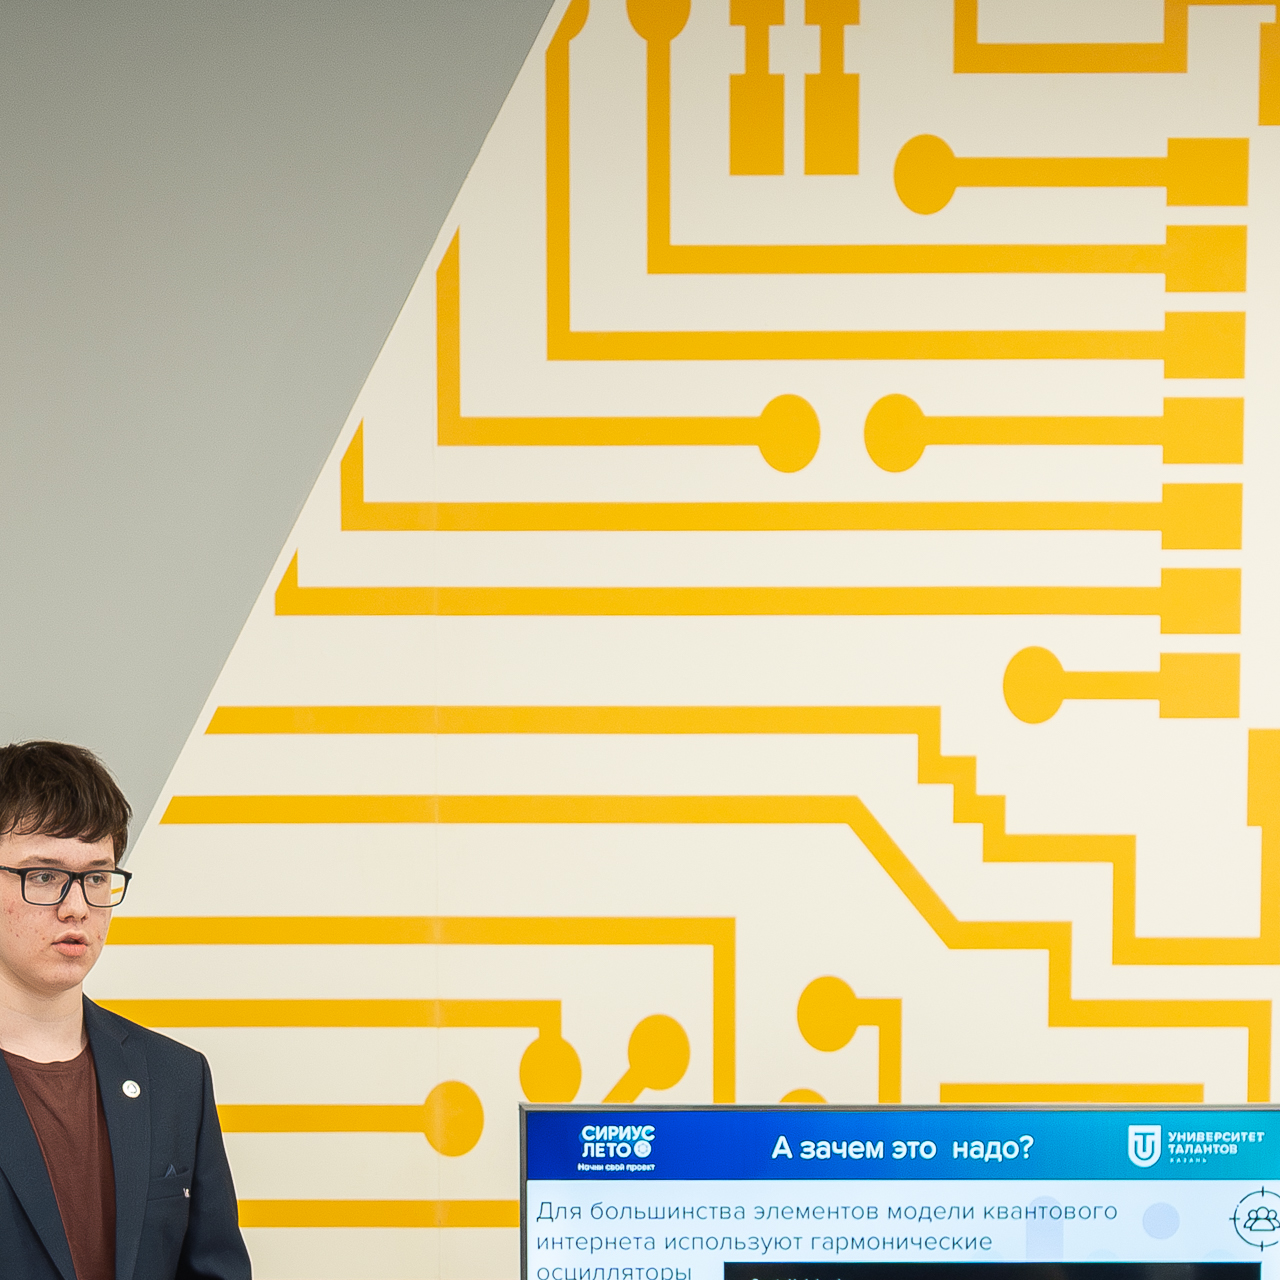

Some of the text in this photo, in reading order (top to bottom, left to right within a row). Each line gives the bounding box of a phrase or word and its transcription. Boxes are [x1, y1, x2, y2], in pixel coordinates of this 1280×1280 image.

[581, 1125, 656, 1141] СИРИУС
[1168, 1131, 1266, 1143] УНИВЕРСИТЕТ
[581, 1142, 631, 1158] ЛЕТО
[771, 1134, 1035, 1163] А зачем это надо?
[1168, 1143, 1238, 1155] ТАЛАНТОВ
[577, 1162, 656, 1173] Начни свой проект
[536, 1201, 1118, 1223] Для большинства элементов модели квантового
[536, 1235, 993, 1255] интернета используют гармонические
